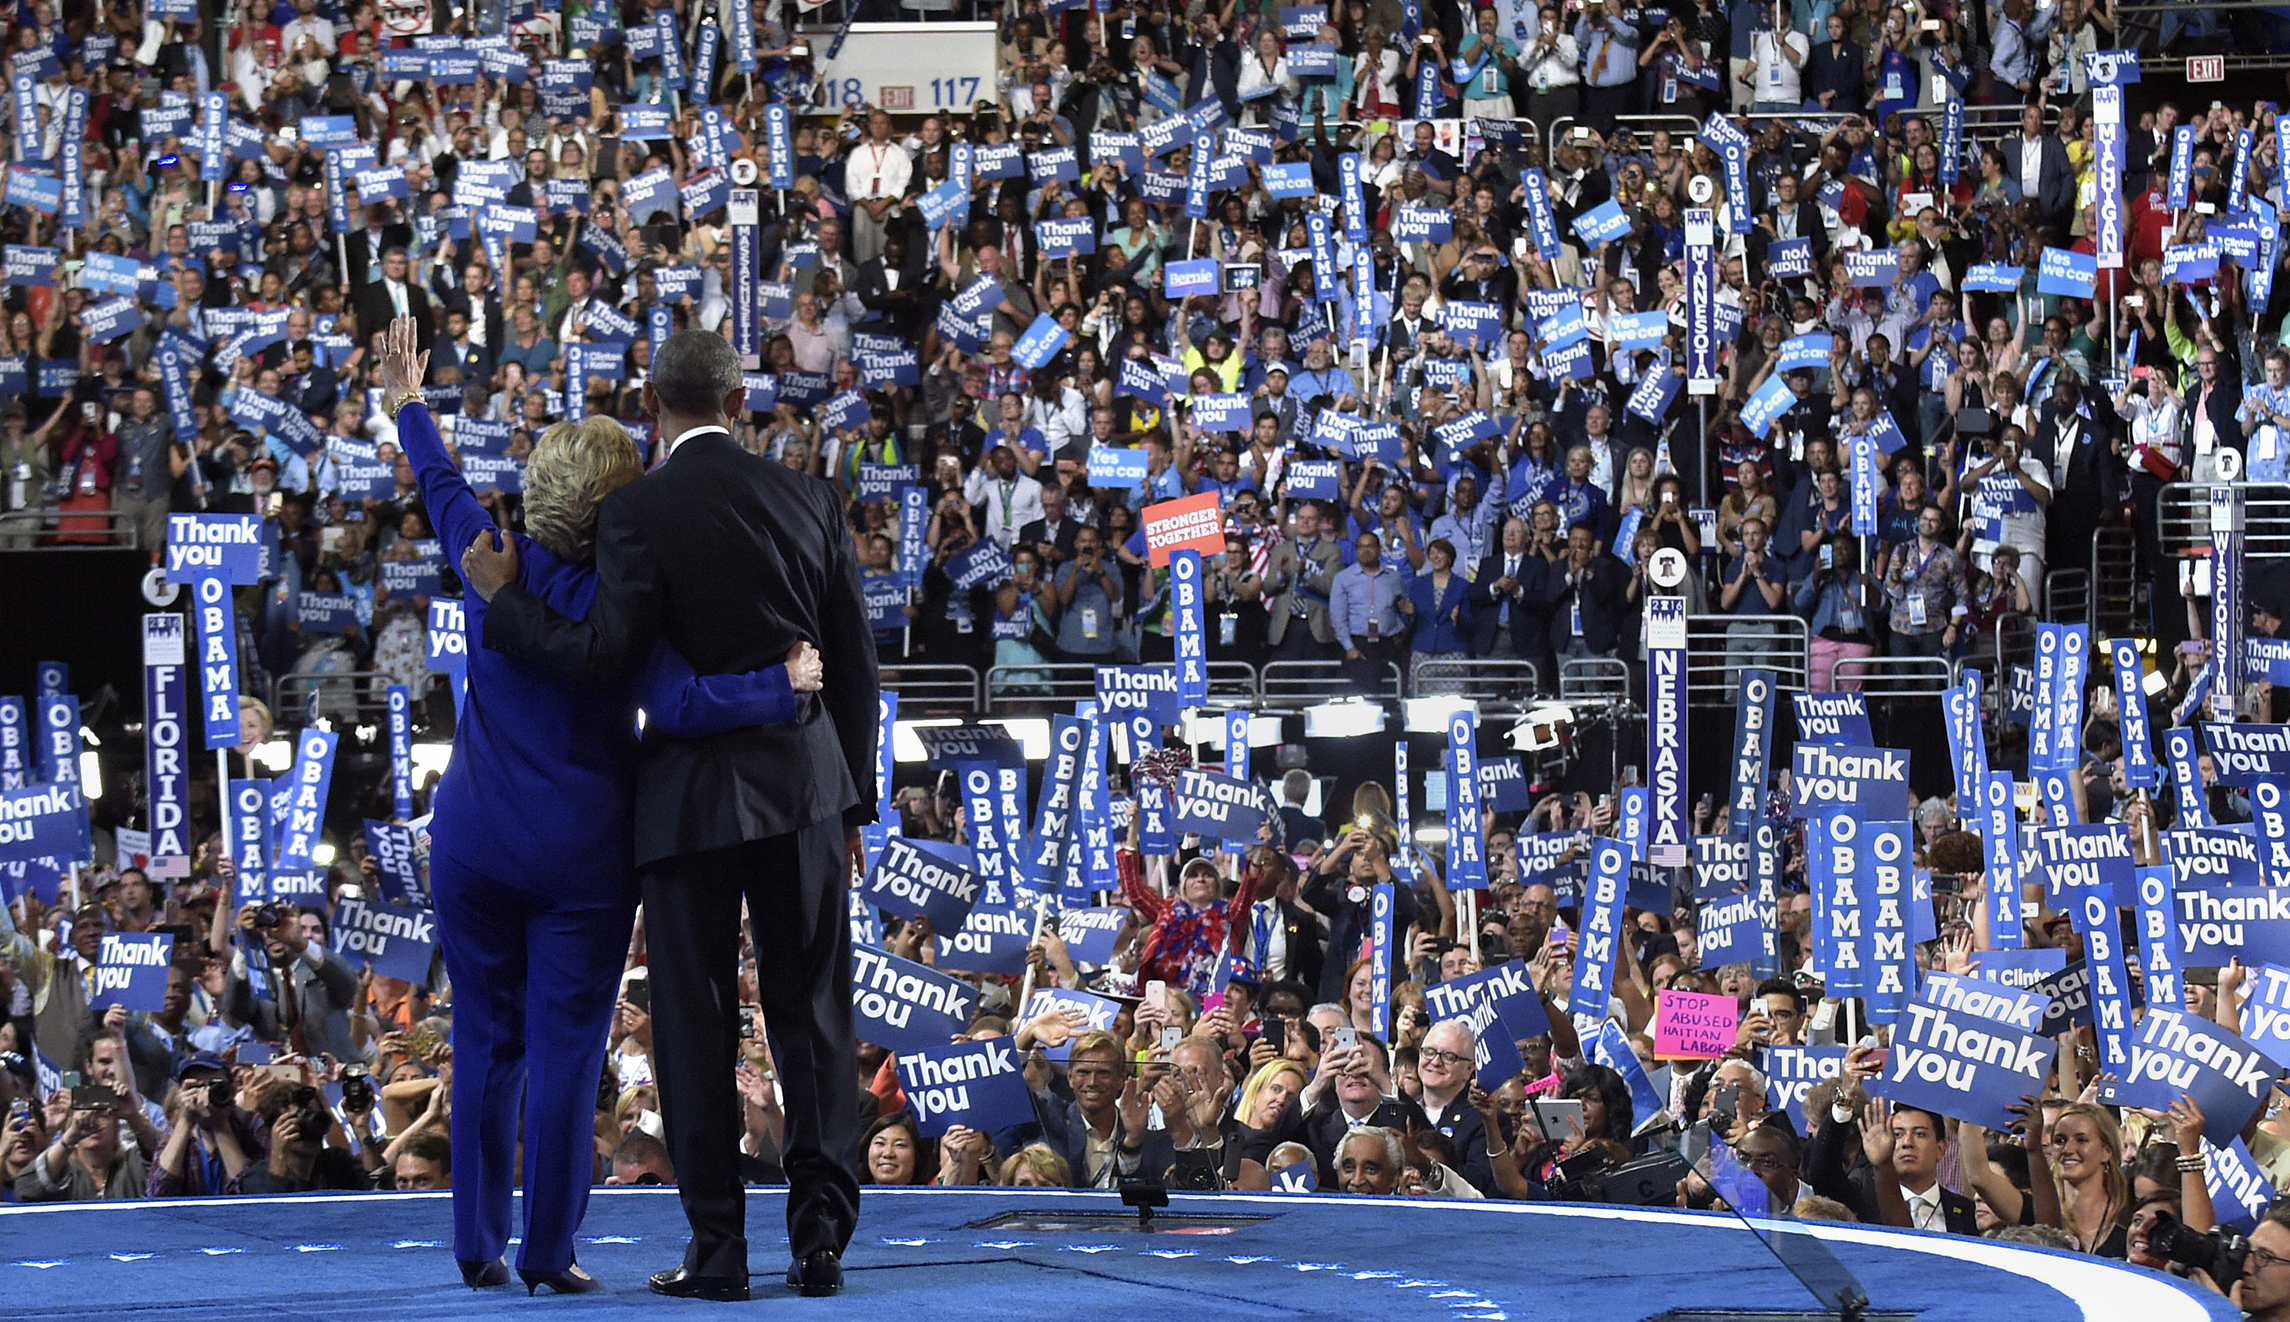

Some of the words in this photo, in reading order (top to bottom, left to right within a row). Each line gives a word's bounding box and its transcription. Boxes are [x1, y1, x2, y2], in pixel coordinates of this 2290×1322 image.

[658, 14, 680, 79] OBAMA
[1303, 51, 1334, 60] Clinton
[1304, 58, 1328, 67] Kaine
[2192, 59, 2221, 79] EXIT
[931, 77, 981, 106] 117
[19, 78, 38, 148] OBAMA
[305, 118, 328, 131] Yes
[639, 111, 671, 120] Clinton
[640, 119, 665, 127] Kaine
[209, 96, 224, 168] OBAMA
[770, 107, 788, 178] OBAMA
[1090, 132, 1138, 147] Thank
[1943, 102, 1959, 172] OBAMA
[975, 147, 1021, 163] Thank
[1028, 148, 1076, 166] Thank
[1192, 136, 1211, 206] OBAMA
[2172, 129, 2190, 197] OBAMA
[2229, 134, 2248, 206] OBAMA
[1264, 167, 1287, 179] Yes
[1264, 178, 1286, 190] we
[1286, 178, 1314, 190] can
[1726, 147, 1746, 221] OBAMA
[2099, 123, 2118, 252] MICHIGAN
[1342, 157, 1361, 230] OBAMA
[487, 205, 536, 222] Thank
[1401, 209, 1449, 223] Thank
[1527, 174, 1554, 246] OBAMA
[1573, 216, 1598, 234] Yes
[1043, 221, 1092, 236] Thank
[2224, 239, 2255, 249] Clinton
[89, 252, 113, 268] Yes
[655, 266, 702, 281] Thank
[1848, 252, 1897, 268] Thank
[2042, 265, 2068, 278] we
[2045, 251, 2071, 267] Yes
[740, 227, 750, 354] MASSACHUSETTS
[1169, 269, 1213, 287] Bernie
[1356, 255, 1371, 326] OBAMA
[1611, 318, 1639, 329] Yes
[1692, 246, 1709, 379] MINNESOTA
[1023, 345, 1046, 369] we
[1041, 322, 1062, 351] can
[1613, 329, 1640, 339] we
[1639, 325, 1668, 338] can
[1780, 340, 1804, 352] Yes
[589, 352, 623, 362] Clinton
[863, 351, 916, 367] Thank
[1012, 337, 1037, 360] Yes
[1779, 349, 1800, 362] we
[1800, 348, 1828, 359] can
[589, 361, 617, 370] Kaine
[162, 352, 192, 428] OBAMA
[1195, 394, 1248, 410] Thank
[1741, 397, 1763, 422] Yes
[1750, 410, 1766, 431] we
[1764, 388, 1790, 414] can
[1352, 424, 1398, 440] Thank
[339, 465, 393, 480] Thank
[463, 456, 518, 471] Thank
[861, 466, 913, 481] Thank
[1091, 465, 1115, 477] we
[1116, 466, 1147, 478] can
[1093, 452, 1119, 464] Yes
[1288, 463, 1337, 478] Thank
[1854, 441, 1871, 521] OBAMA
[171, 516, 258, 544] Thank
[905, 492, 921, 571] OBAMA
[1146, 509, 1217, 538] STRONGER
[1148, 522, 1220, 549] TOGETHER
[170, 545, 222, 572] you
[1176, 557, 1201, 683] OBAMA
[2213, 533, 2229, 695] WISCONSIN
[201, 577, 233, 721] OBAMA
[1098, 668, 1177, 692] Thank
[2034, 630, 2056, 756] OBAMA
[2058, 631, 2082, 749] OBAMA
[1098, 689, 1148, 713] you
[1794, 694, 1865, 717] Thank
[2117, 646, 2147, 766] OBAMA
[1799, 717, 1840, 739] you
[390, 693, 410, 799] OBAMA
[1655, 651, 1678, 844] NEBRASKA
[1737, 679, 1767, 810] OBAMA
[154, 666, 184, 856] FLORIDA
[1798, 745, 1906, 781] Thank
[289, 737, 329, 857] OBAMA
[1036, 726, 1080, 866] OBAMA
[1182, 771, 1266, 811] Thank
[1453, 718, 1478, 861] OBAMA
[968, 769, 1007, 904] OBAMA
[1988, 780, 2014, 921] OBAMA
[2041, 826, 2131, 862] Thank
[2172, 830, 2257, 862] Thank
[871, 866, 932, 907] you
[881, 841, 980, 902] Thank
[2044, 861, 2099, 895] you
[1829, 814, 1861, 969] OBAMA
[340, 899, 436, 944] Thank
[1581, 849, 1622, 990] OBAMA
[1701, 895, 1758, 932] Thank
[1873, 832, 1905, 992] OBAMA
[102, 936, 169, 967] Thank
[333, 927, 385, 956] you
[1696, 925, 1732, 952] you
[2178, 922, 2244, 953] you
[1372, 893, 1387, 1032] OBAMA
[97, 966, 131, 996] you
[852, 950, 971, 1022] Thank
[2084, 896, 2126, 1063] OBAMA
[1664, 994, 1709, 1010] STOP
[1925, 974, 2040, 1028] Thank
[1663, 1026, 1721, 1041] HAITIAN
[1671, 1012, 1732, 1028] ABUSED
[1907, 1002, 2048, 1079] Thank
[2141, 1008, 2270, 1099] Thank
[900, 1042, 1016, 1088] Thank
[1891, 1042, 1977, 1092] you
[2125, 1045, 2199, 1089] you
[908, 1085, 971, 1122] you
